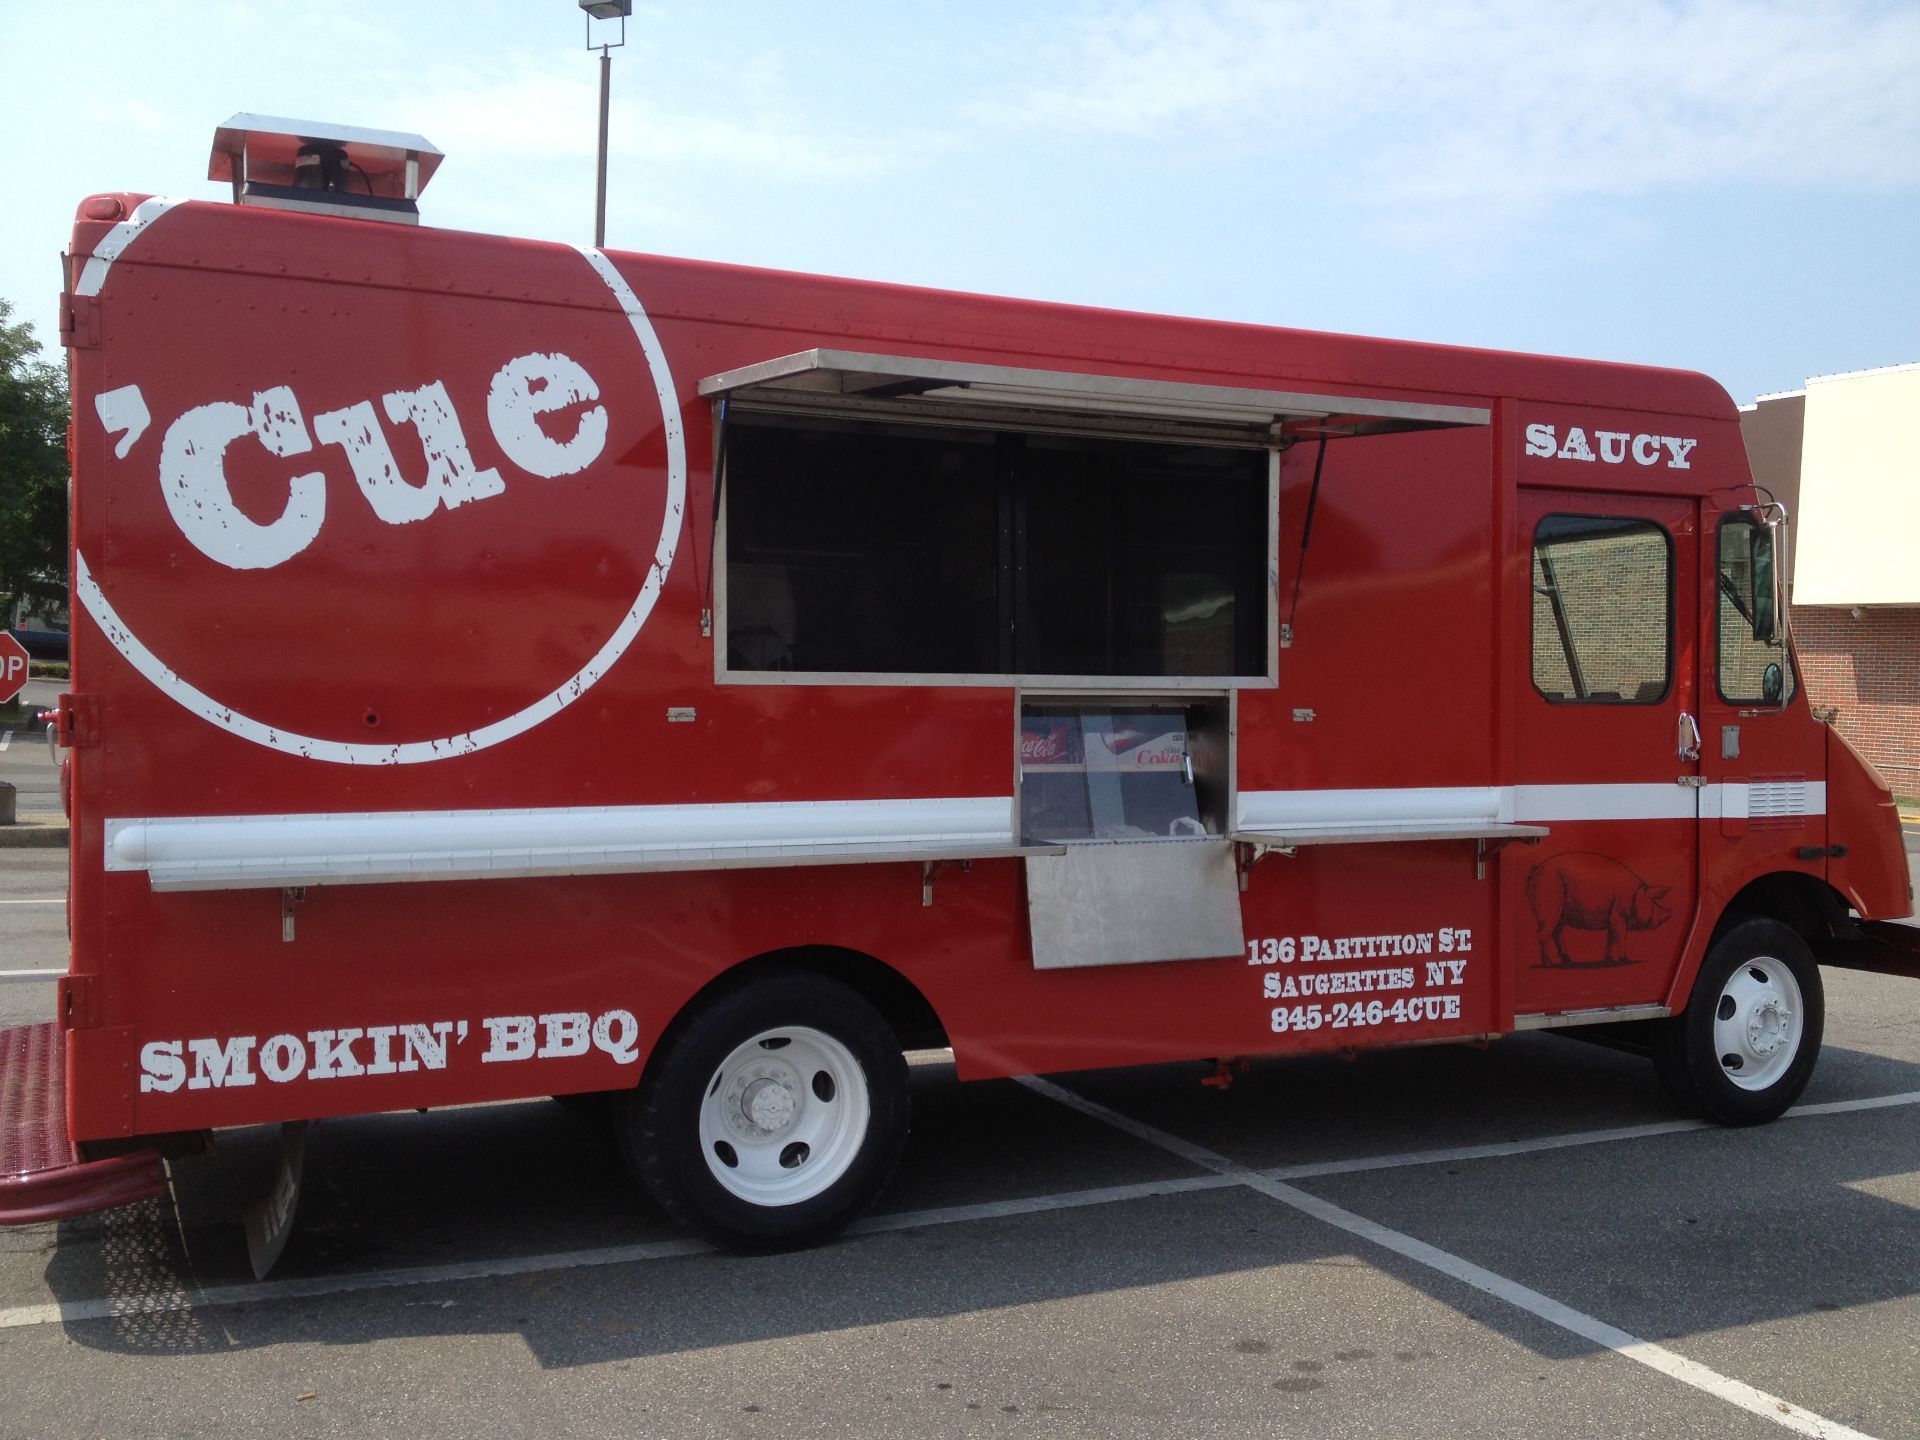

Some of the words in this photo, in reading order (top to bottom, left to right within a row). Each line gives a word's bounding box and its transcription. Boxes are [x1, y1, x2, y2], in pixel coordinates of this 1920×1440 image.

[1525, 422, 1698, 470] SAUCY
[1136, 748, 1184, 767] Coke
[1247, 936, 1296, 966] 136
[1300, 932, 1434, 962] PARTITION
[1438, 927, 1472, 953] ST
[1263, 967, 1415, 999] SAUGERTIES
[1425, 959, 1467, 987] NY
[1271, 995, 1461, 1033] 845-246-4CUE
[139, 1019, 469, 1093] SMOKIN'
[481, 1008, 640, 1066] BBQ
